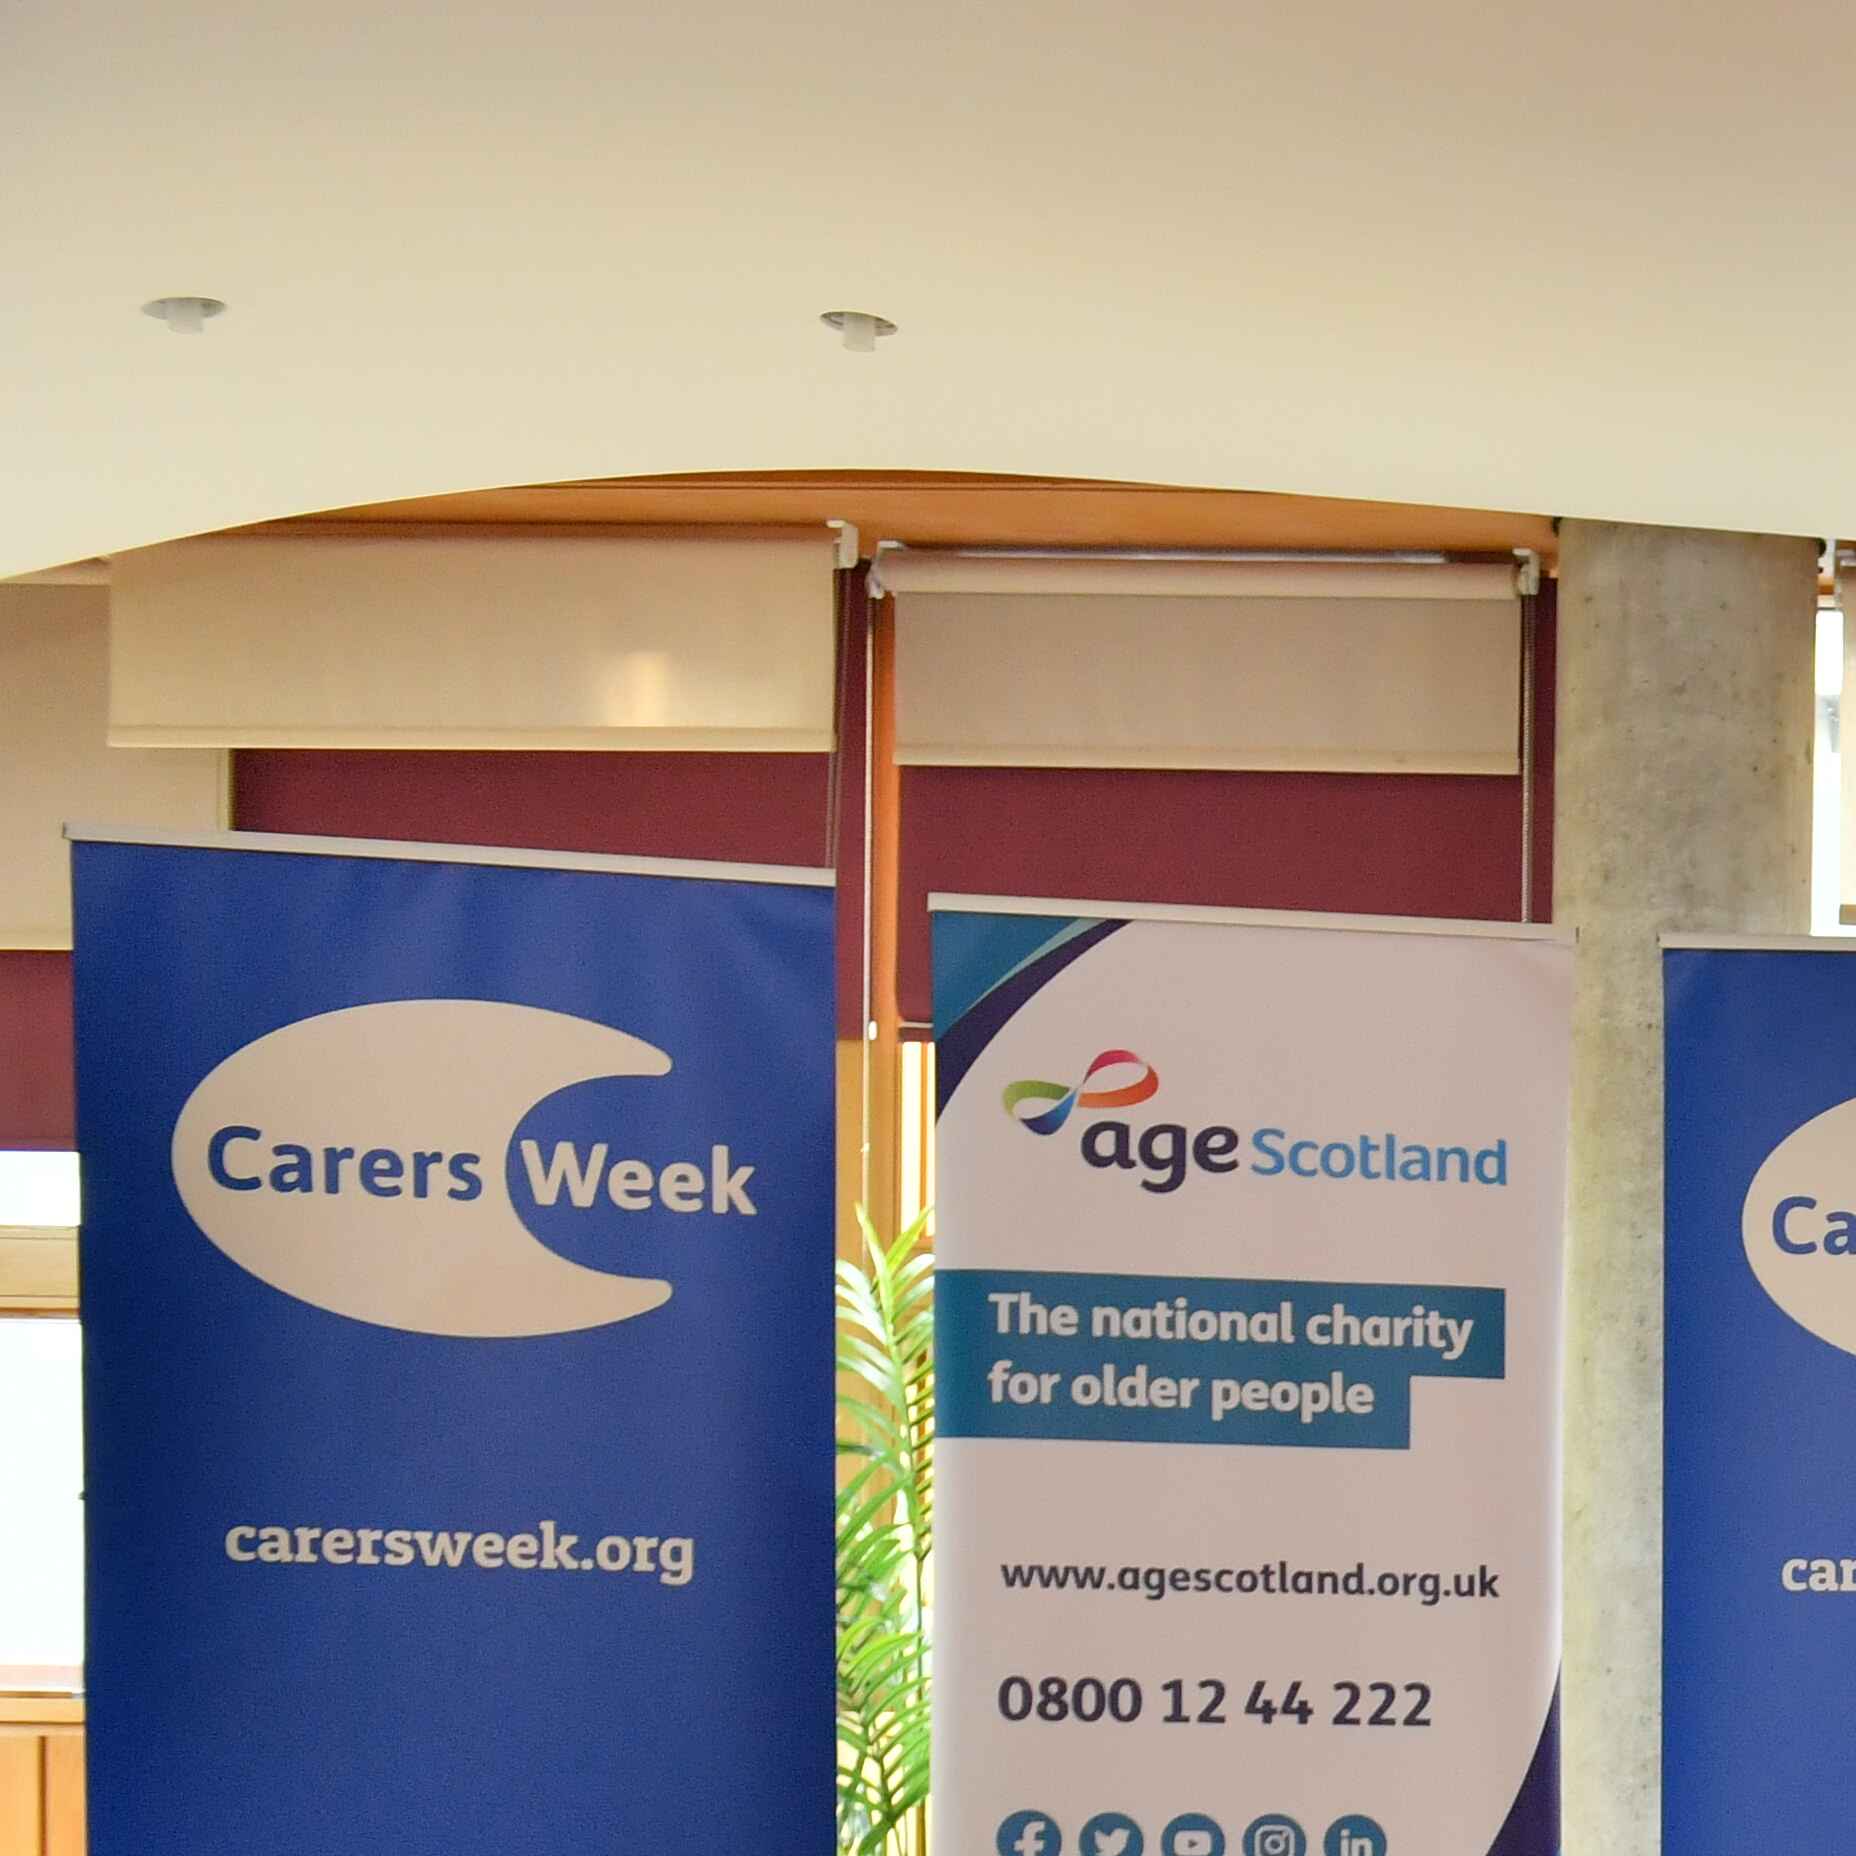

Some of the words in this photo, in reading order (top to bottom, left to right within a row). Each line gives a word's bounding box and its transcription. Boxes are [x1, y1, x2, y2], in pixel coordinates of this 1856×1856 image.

[208, 1126, 482, 1200] Carers
[520, 1140, 756, 1216] Week
[1082, 1121, 1238, 1193] age
[1251, 1128, 1507, 1186] Scotland
[989, 1292, 1078, 1335] The
[1093, 1298, 1294, 1343] national
[1307, 1304, 1473, 1360] charity
[988, 1360, 1060, 1403] for
[1072, 1364, 1199, 1408] older
[1212, 1372, 1374, 1423] people
[227, 1521, 693, 1585] carersweek.org
[1001, 1561, 1498, 1606] www.agescotland.org.uk
[999, 1677, 1142, 1722] 0800
[1162, 1680, 1225, 1723] 12
[1245, 1681, 1313, 1724] 44
[1333, 1682, 1430, 1726] 222
